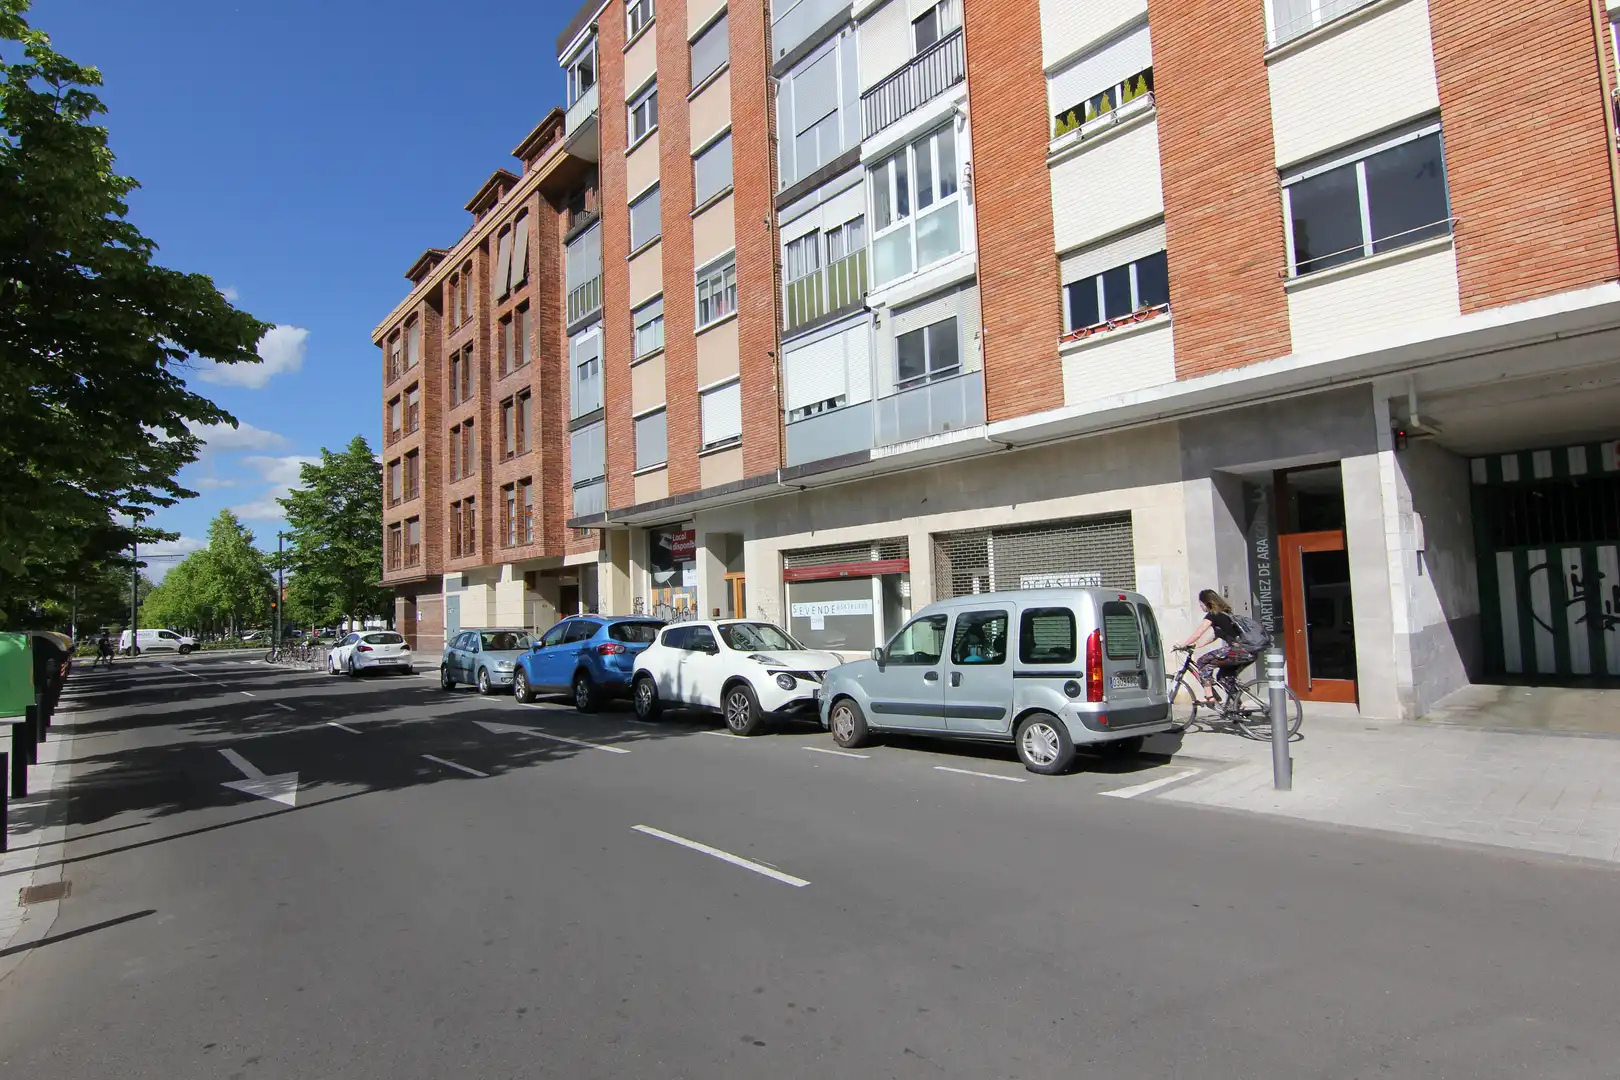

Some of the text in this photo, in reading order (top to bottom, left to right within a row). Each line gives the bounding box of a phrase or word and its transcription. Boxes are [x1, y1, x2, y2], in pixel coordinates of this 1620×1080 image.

[672, 531, 687, 542] Local
[1258, 562, 1270, 577] DE
[1259, 579, 1274, 632] MARTINEZ
